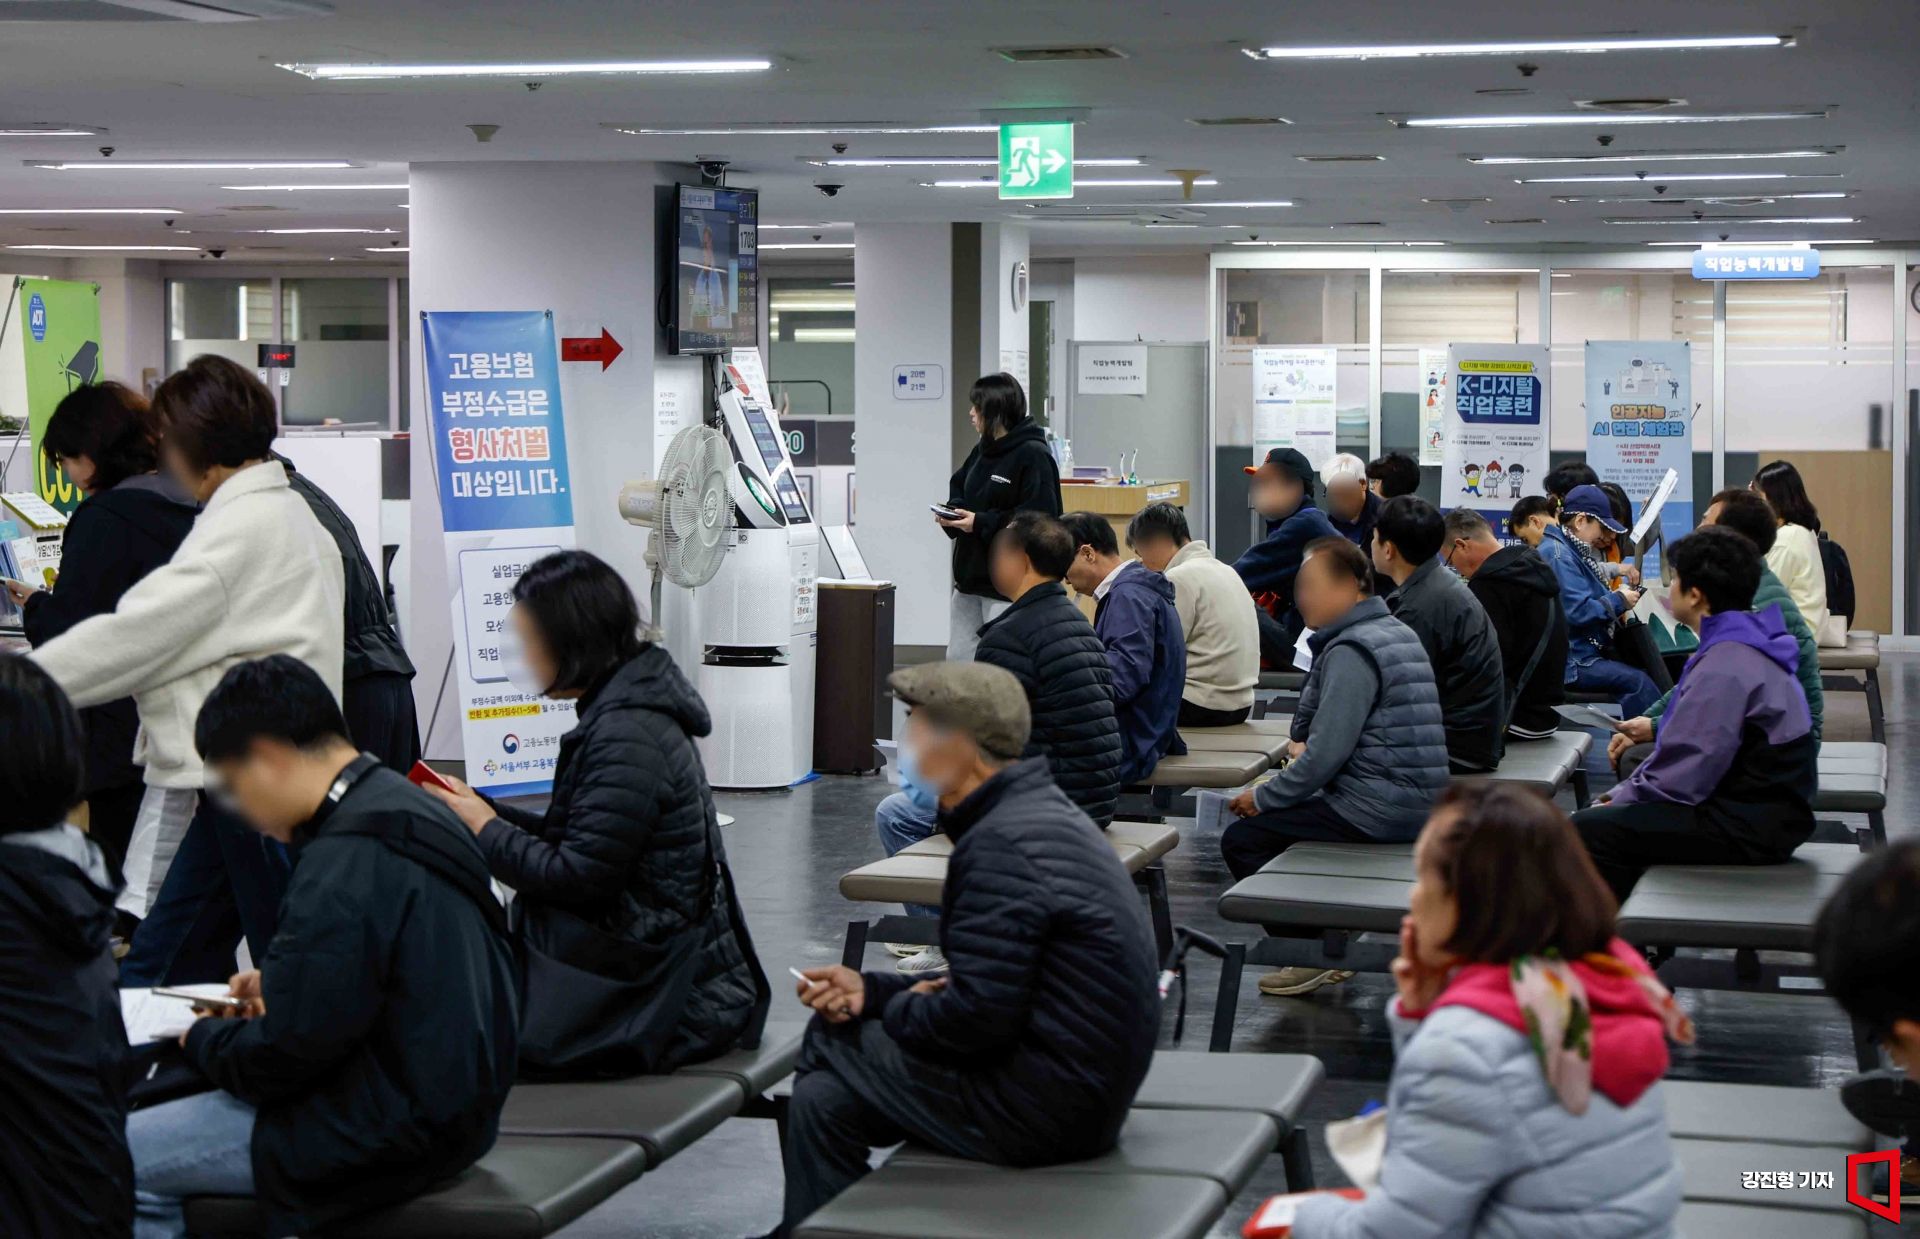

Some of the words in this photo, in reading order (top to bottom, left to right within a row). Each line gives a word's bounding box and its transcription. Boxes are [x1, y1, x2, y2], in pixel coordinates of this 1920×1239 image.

[740, 231, 755, 249] 1703
[1704, 256, 1805, 273] 직업능력개발팀
[449, 351, 534, 380] 고용보험
[1457, 376, 1534, 396] K-디지털
[442, 389, 549, 418] 부정수급은
[1456, 395, 1533, 417] 직업훈련
[1593, 421, 1610, 436] AI
[448, 425, 550, 463] 형사처벌
[451, 468, 566, 498] 대상입니다.
[523, 736, 558, 748] 고용노동부
[500, 759, 530, 772] 서울서부
